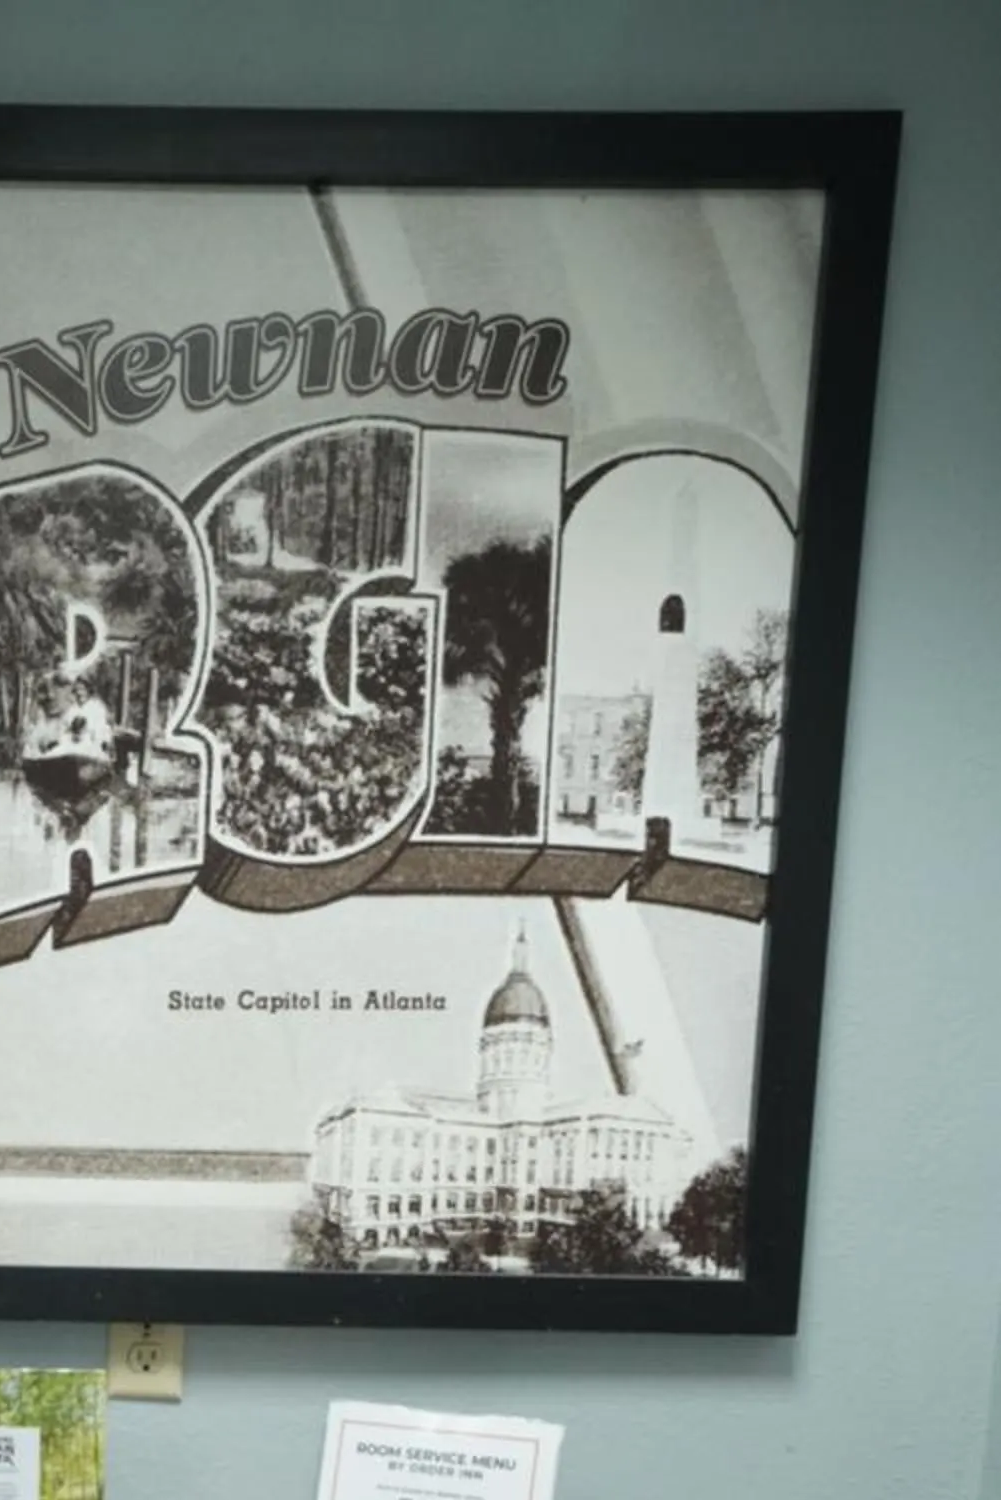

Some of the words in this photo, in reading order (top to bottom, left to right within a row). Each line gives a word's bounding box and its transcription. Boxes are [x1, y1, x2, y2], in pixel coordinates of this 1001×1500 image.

[167, 990, 225, 1011] State
[237, 990, 320, 1014] Capitol
[331, 991, 352, 1011] in
[364, 990, 447, 1012] Atlanta
[357, 1442, 401, 1457] ROOM
[405, 1447, 467, 1466] SERVICE
[472, 1455, 517, 1471] MENU
[388, 1461, 404, 1471] BY
[409, 1462, 455, 1477] ORDER
